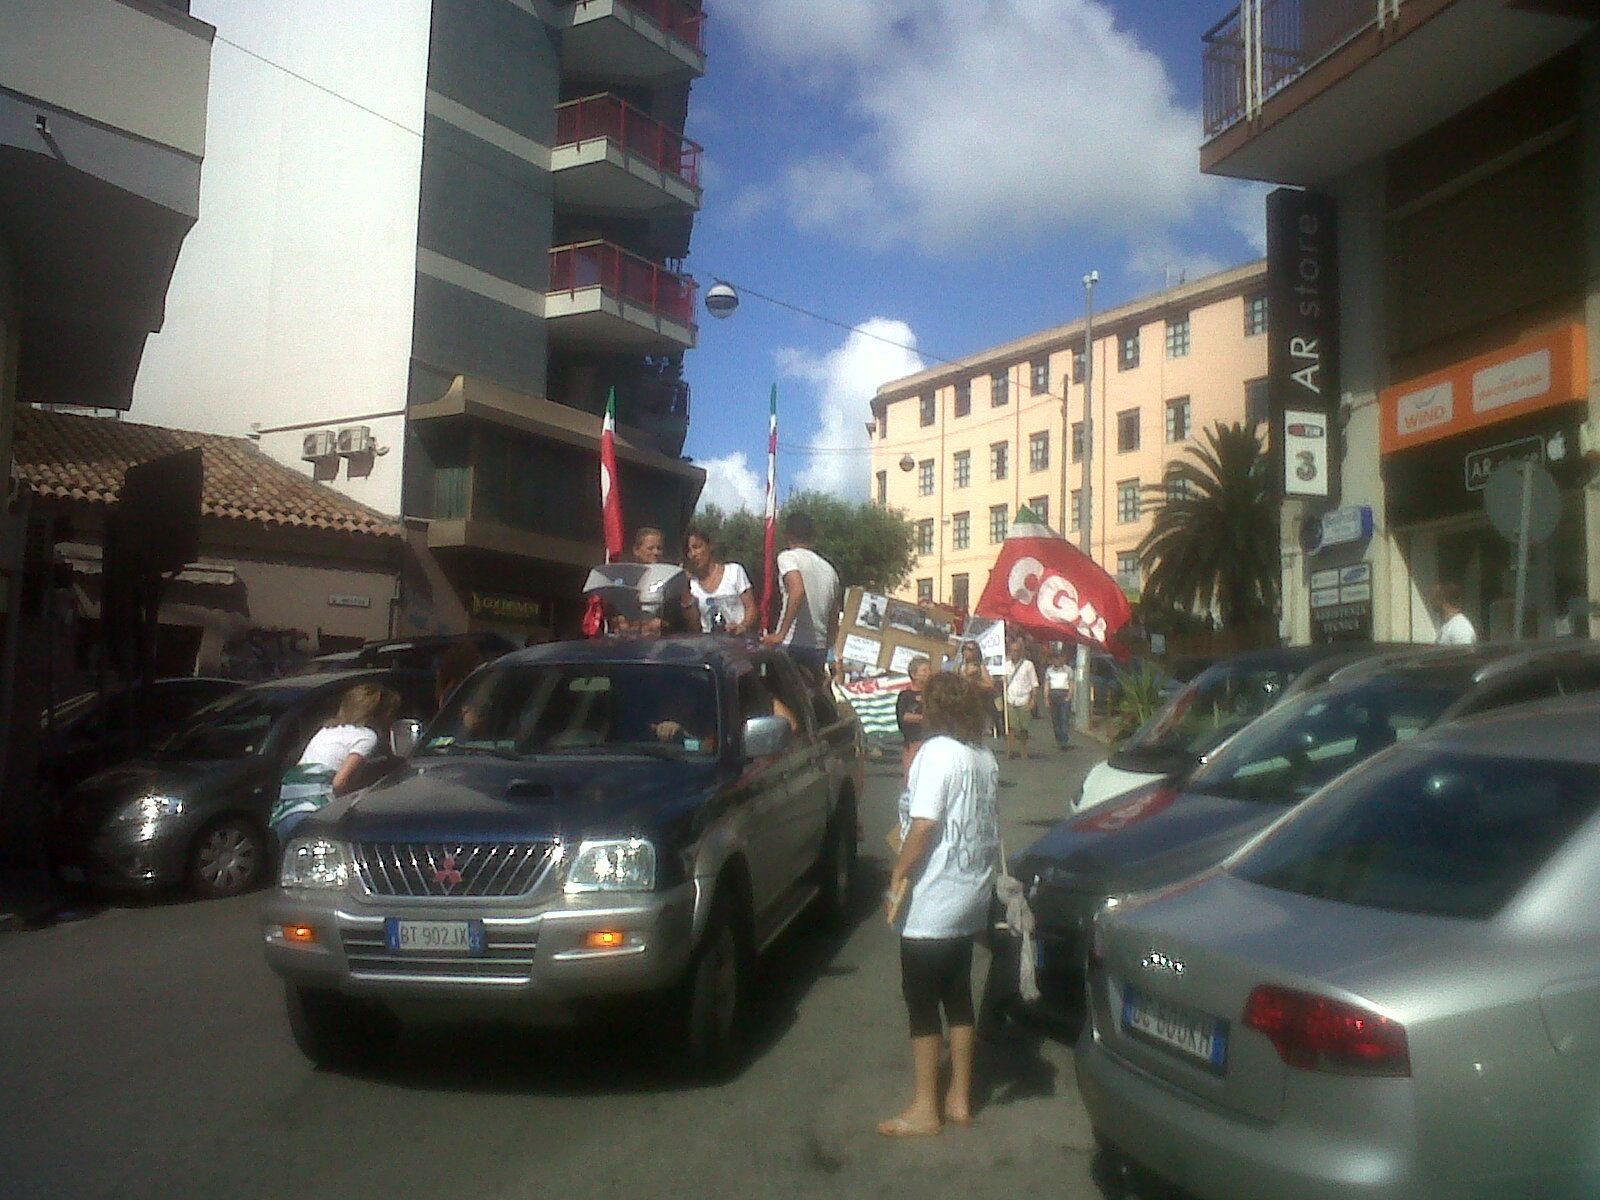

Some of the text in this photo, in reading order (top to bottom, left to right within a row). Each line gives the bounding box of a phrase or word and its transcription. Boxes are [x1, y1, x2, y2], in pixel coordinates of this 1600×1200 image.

[1294, 214, 1320, 318] store
[1290, 336, 1320, 394] AR
[1404, 404, 1447, 429] WIND
[1295, 450, 1318, 482] 3
[401, 926, 417, 945] BT
